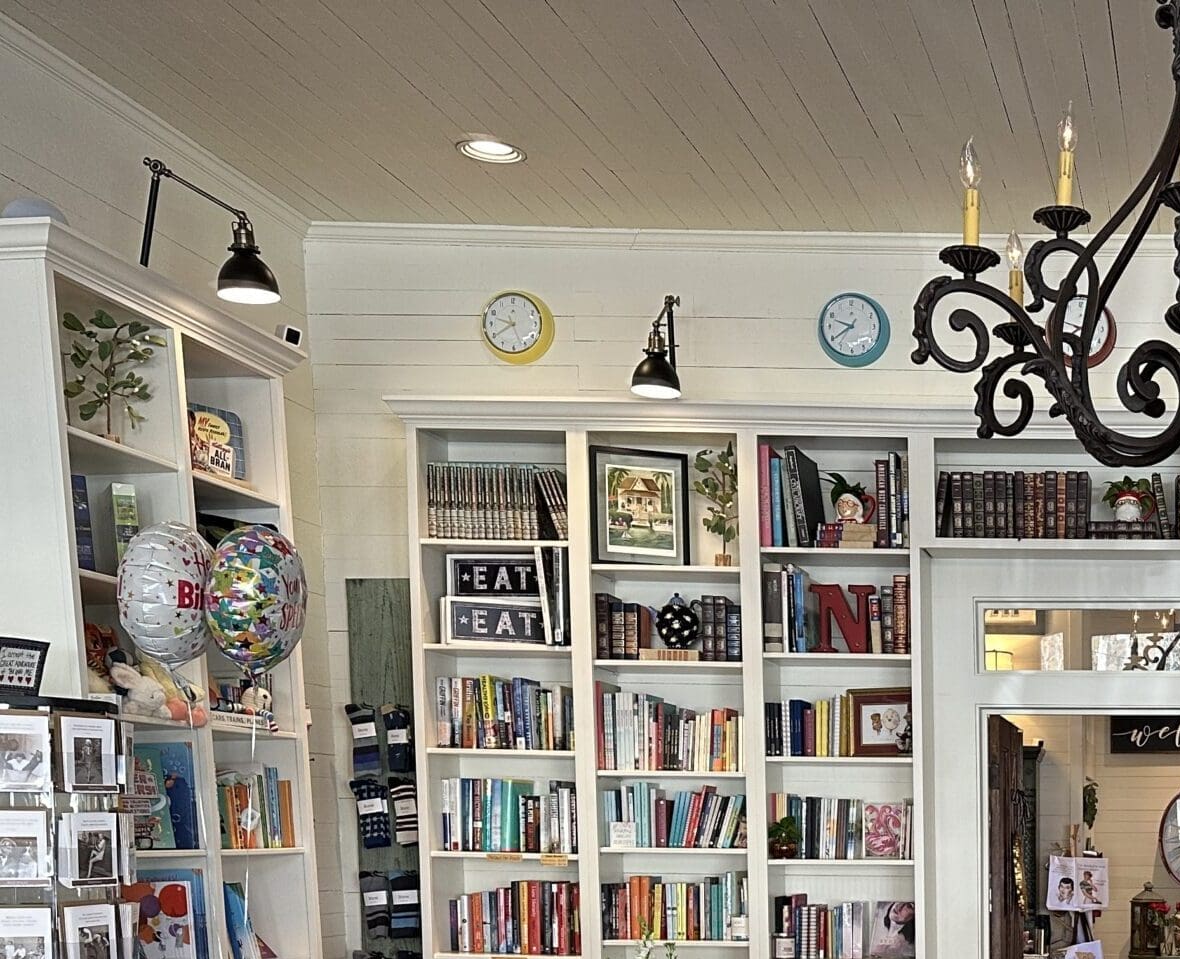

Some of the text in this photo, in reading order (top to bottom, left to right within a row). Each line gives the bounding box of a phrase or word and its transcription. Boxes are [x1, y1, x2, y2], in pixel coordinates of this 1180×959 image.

[210, 456, 230, 472] BRAN
[472, 566, 532, 590] EAT
[471, 609, 537, 637] EAT
[809, 583, 876, 653] N
